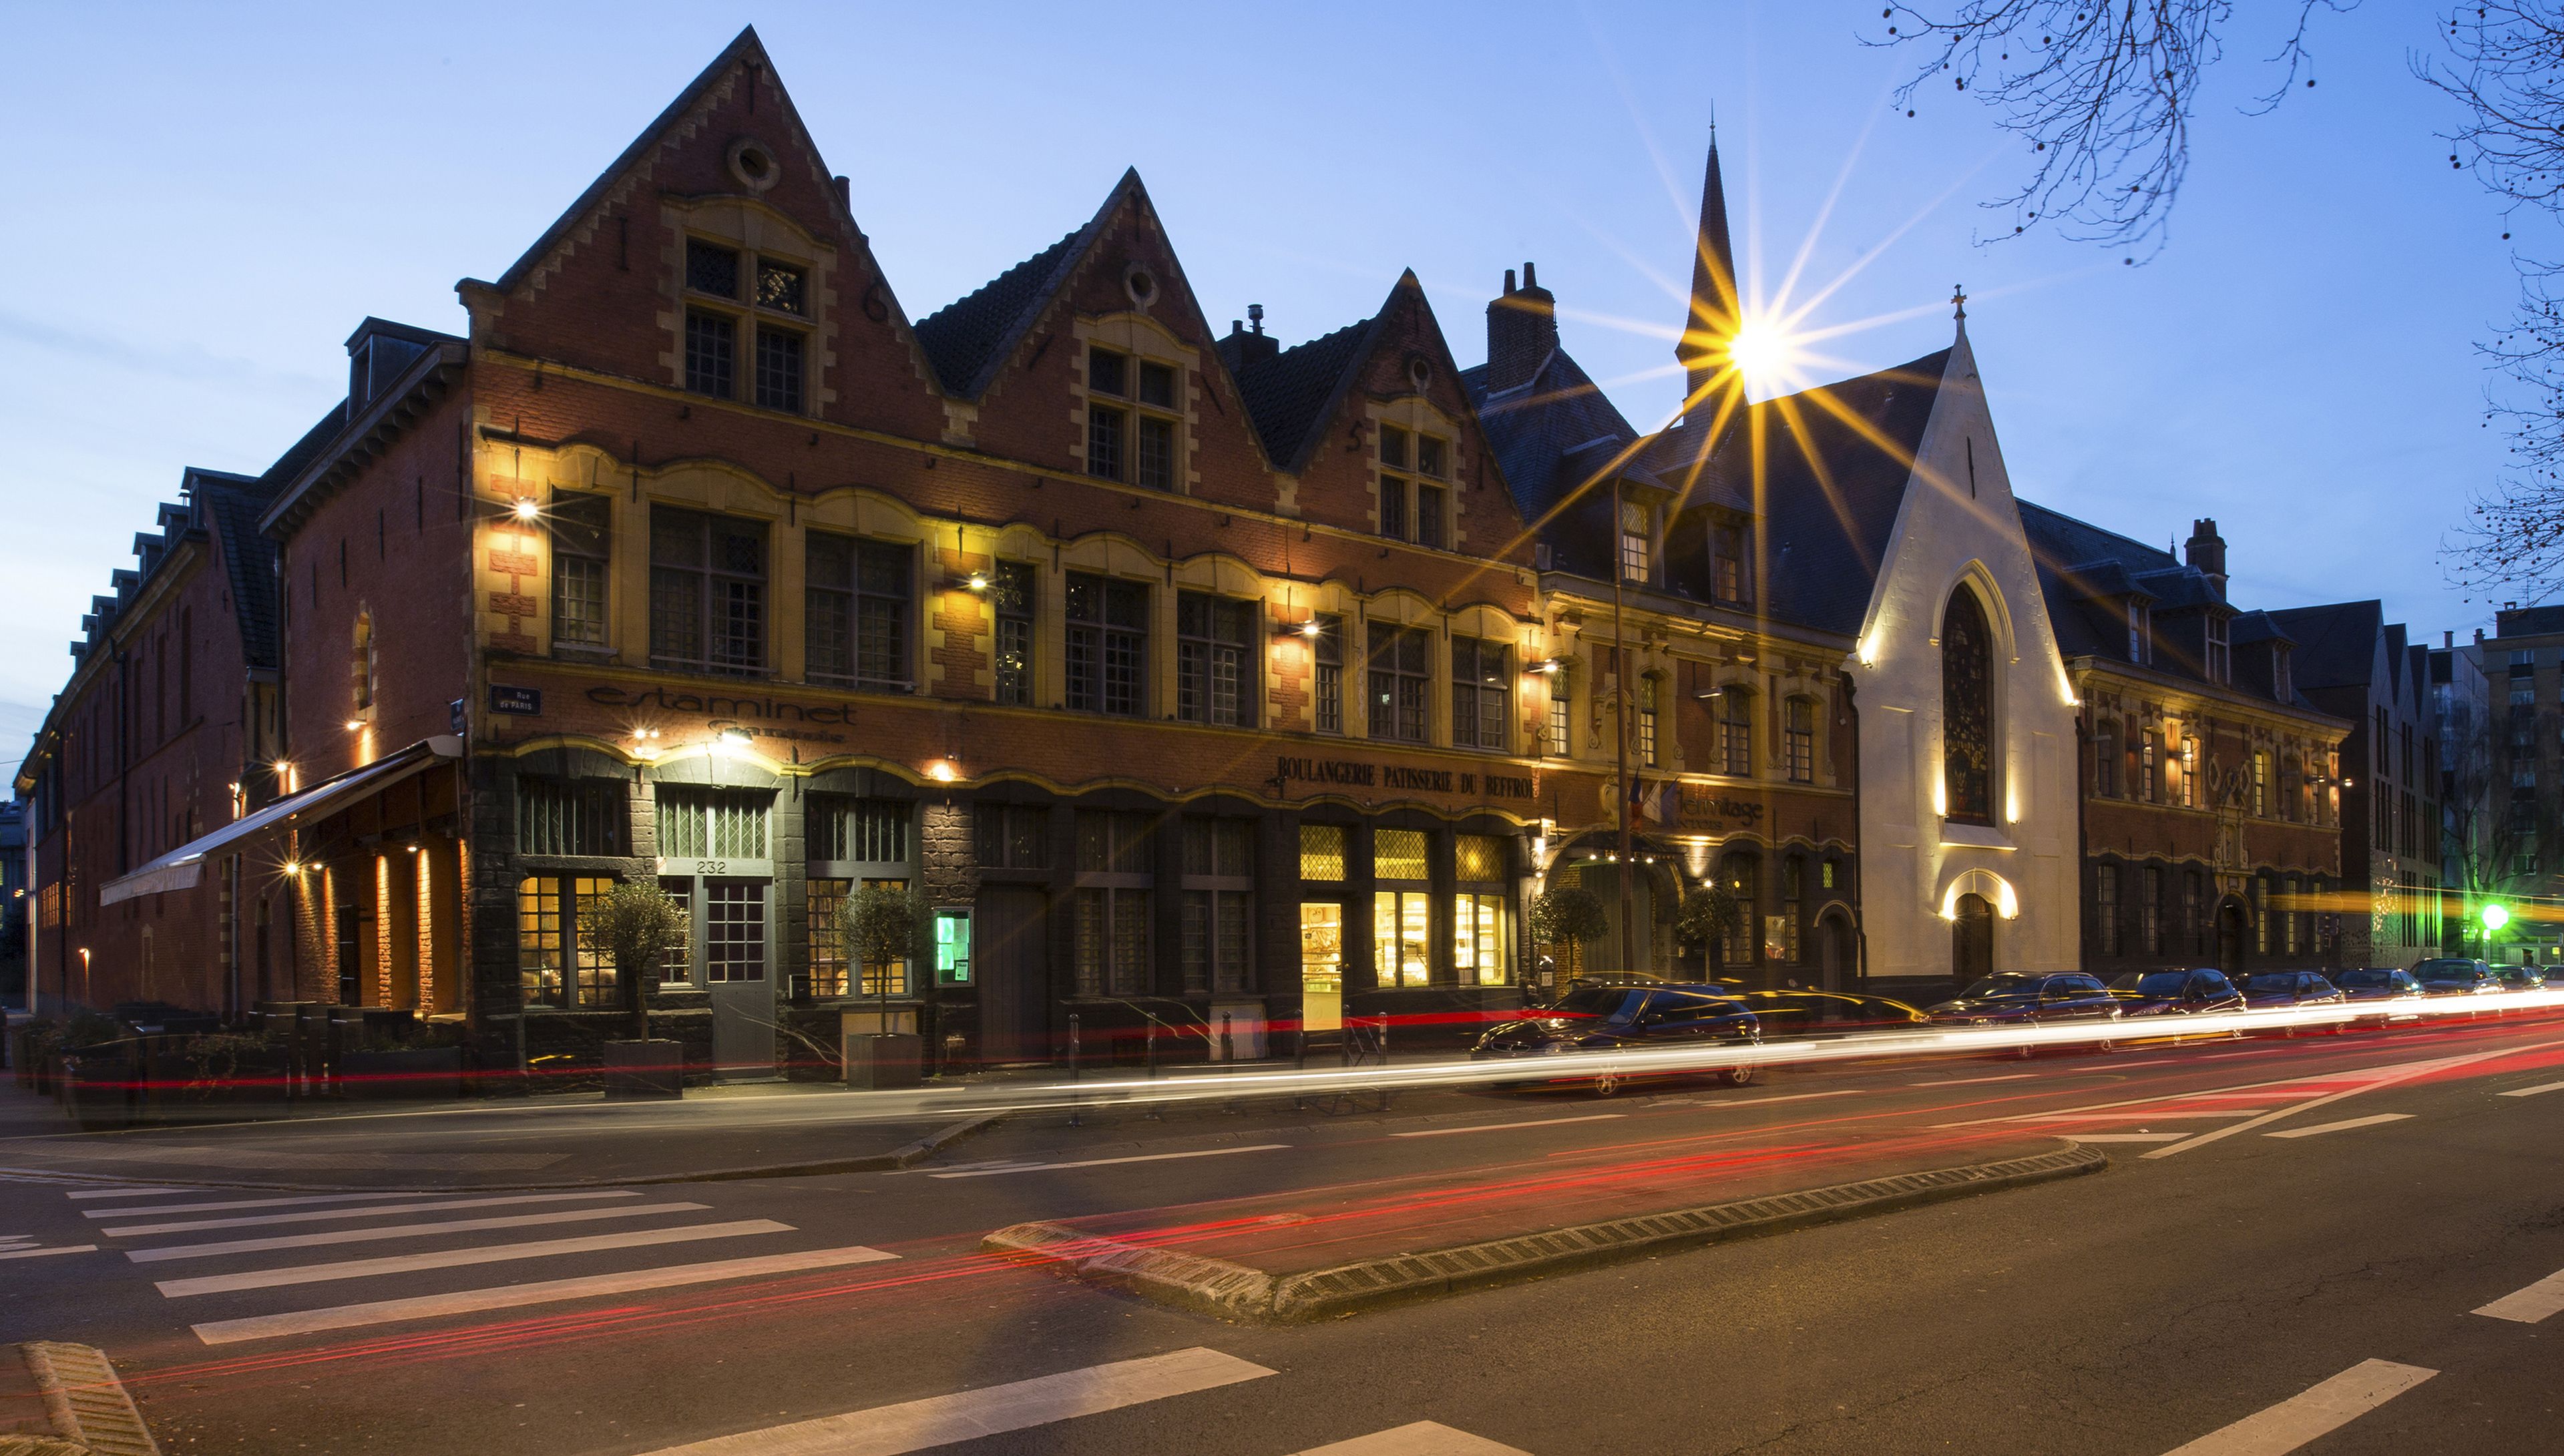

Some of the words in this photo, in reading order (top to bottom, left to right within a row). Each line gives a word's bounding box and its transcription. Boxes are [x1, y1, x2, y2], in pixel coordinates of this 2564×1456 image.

[517, 692, 530, 700] Rue
[511, 702, 532, 710] PARIS
[585, 686, 857, 726] estaminet
[1277, 756, 1375, 786] BOULANGERIE
[1383, 766, 1453, 792] PATISSERIE
[1460, 772, 1478, 794] DU
[1485, 775, 1534, 799] BEFFROI
[696, 861, 726, 874] 232
